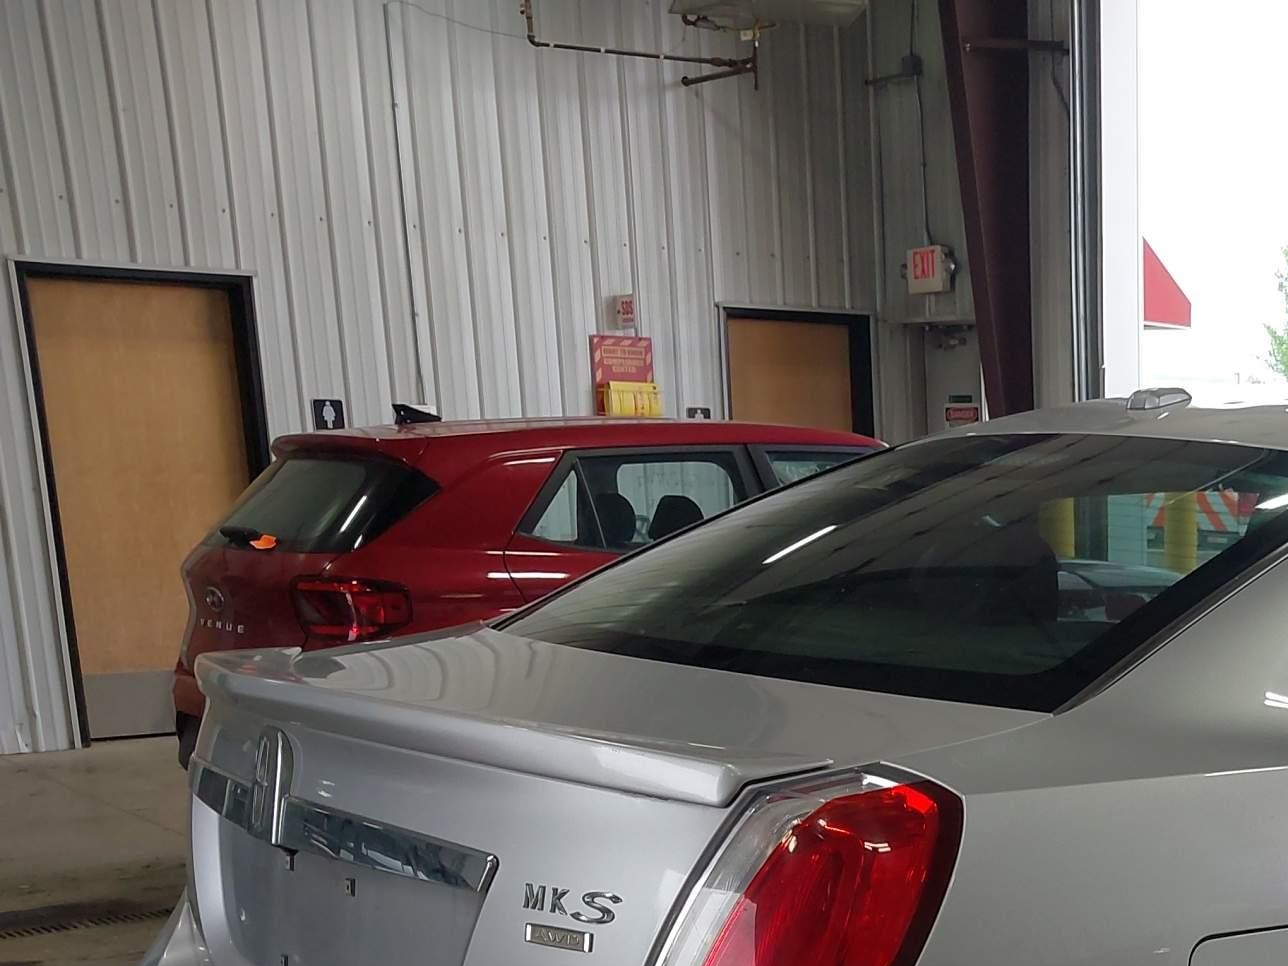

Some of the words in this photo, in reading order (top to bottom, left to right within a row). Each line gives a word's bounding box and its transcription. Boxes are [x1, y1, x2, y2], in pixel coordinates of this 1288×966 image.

[912, 248, 935, 280] EXIT
[200, 618, 245, 633] VENUE
[522, 882, 623, 924] MKS
